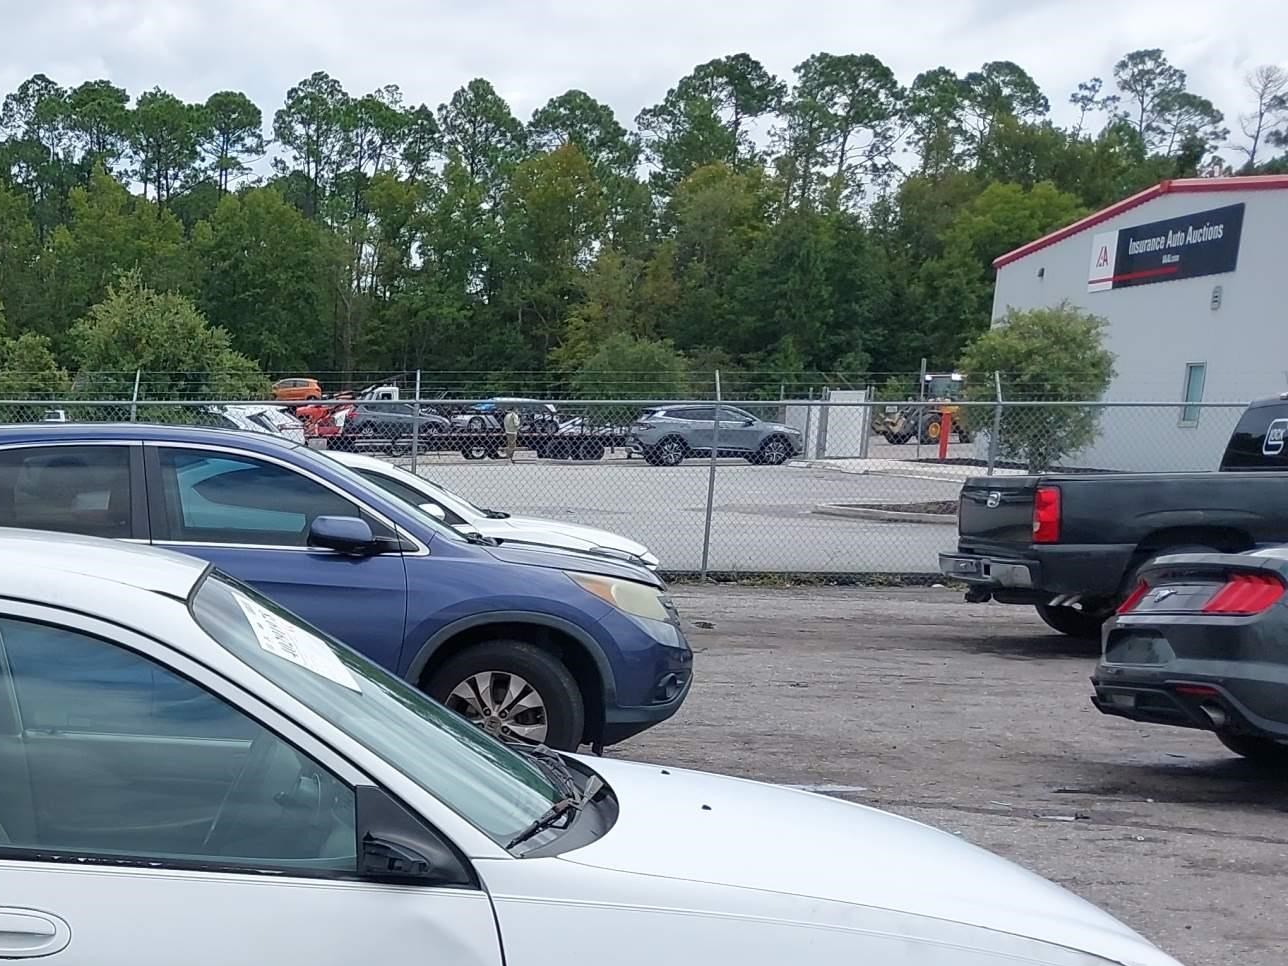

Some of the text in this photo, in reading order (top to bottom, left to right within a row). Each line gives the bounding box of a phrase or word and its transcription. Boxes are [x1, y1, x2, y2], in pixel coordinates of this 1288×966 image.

[1128, 222, 1224, 255] Insurance Auto Auctions
